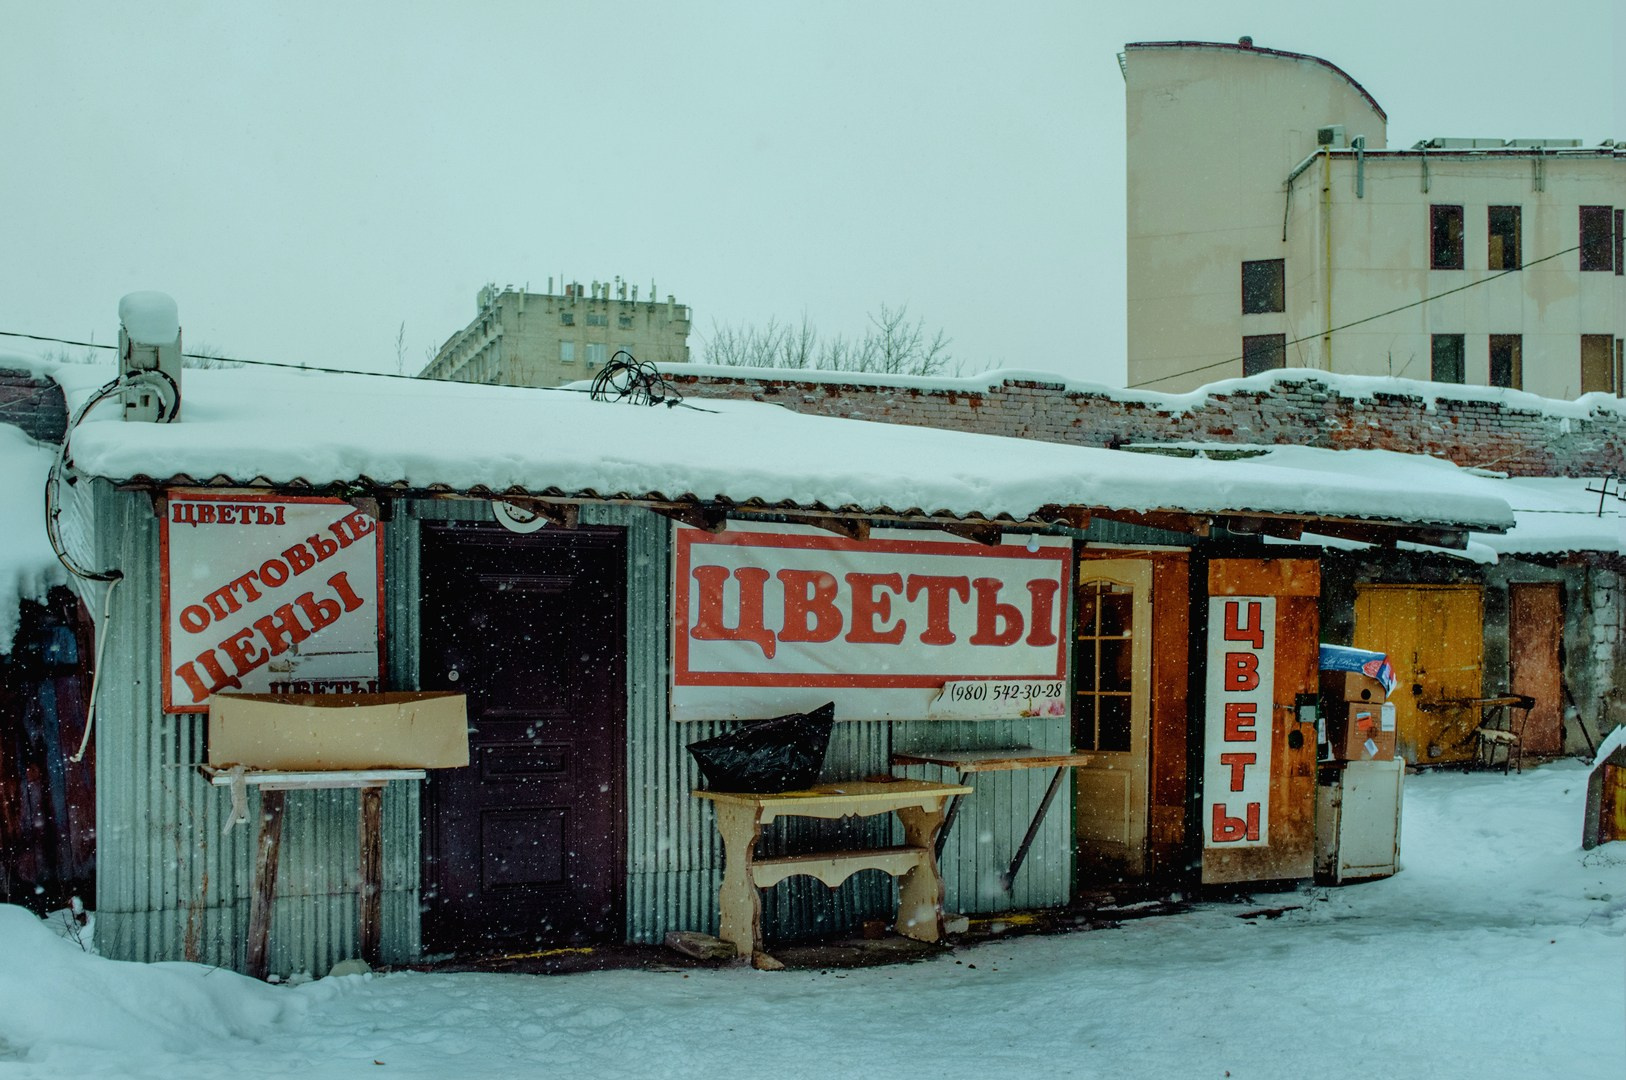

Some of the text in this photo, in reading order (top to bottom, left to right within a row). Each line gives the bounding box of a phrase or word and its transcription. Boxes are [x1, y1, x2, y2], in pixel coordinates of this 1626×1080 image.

[172, 503, 286, 527] ЦВЕТЫ
[179, 510, 375, 634] ОПТОВЫЕ
[690, 565, 1060, 660] ЦВЕТЫ
[175, 571, 364, 703] ЦЕНЫ
[951, 683, 988, 701] (980)
[993, 682, 1063, 700] 542-30-28
[1212, 602, 1265, 843] ЦВЕТЫ
